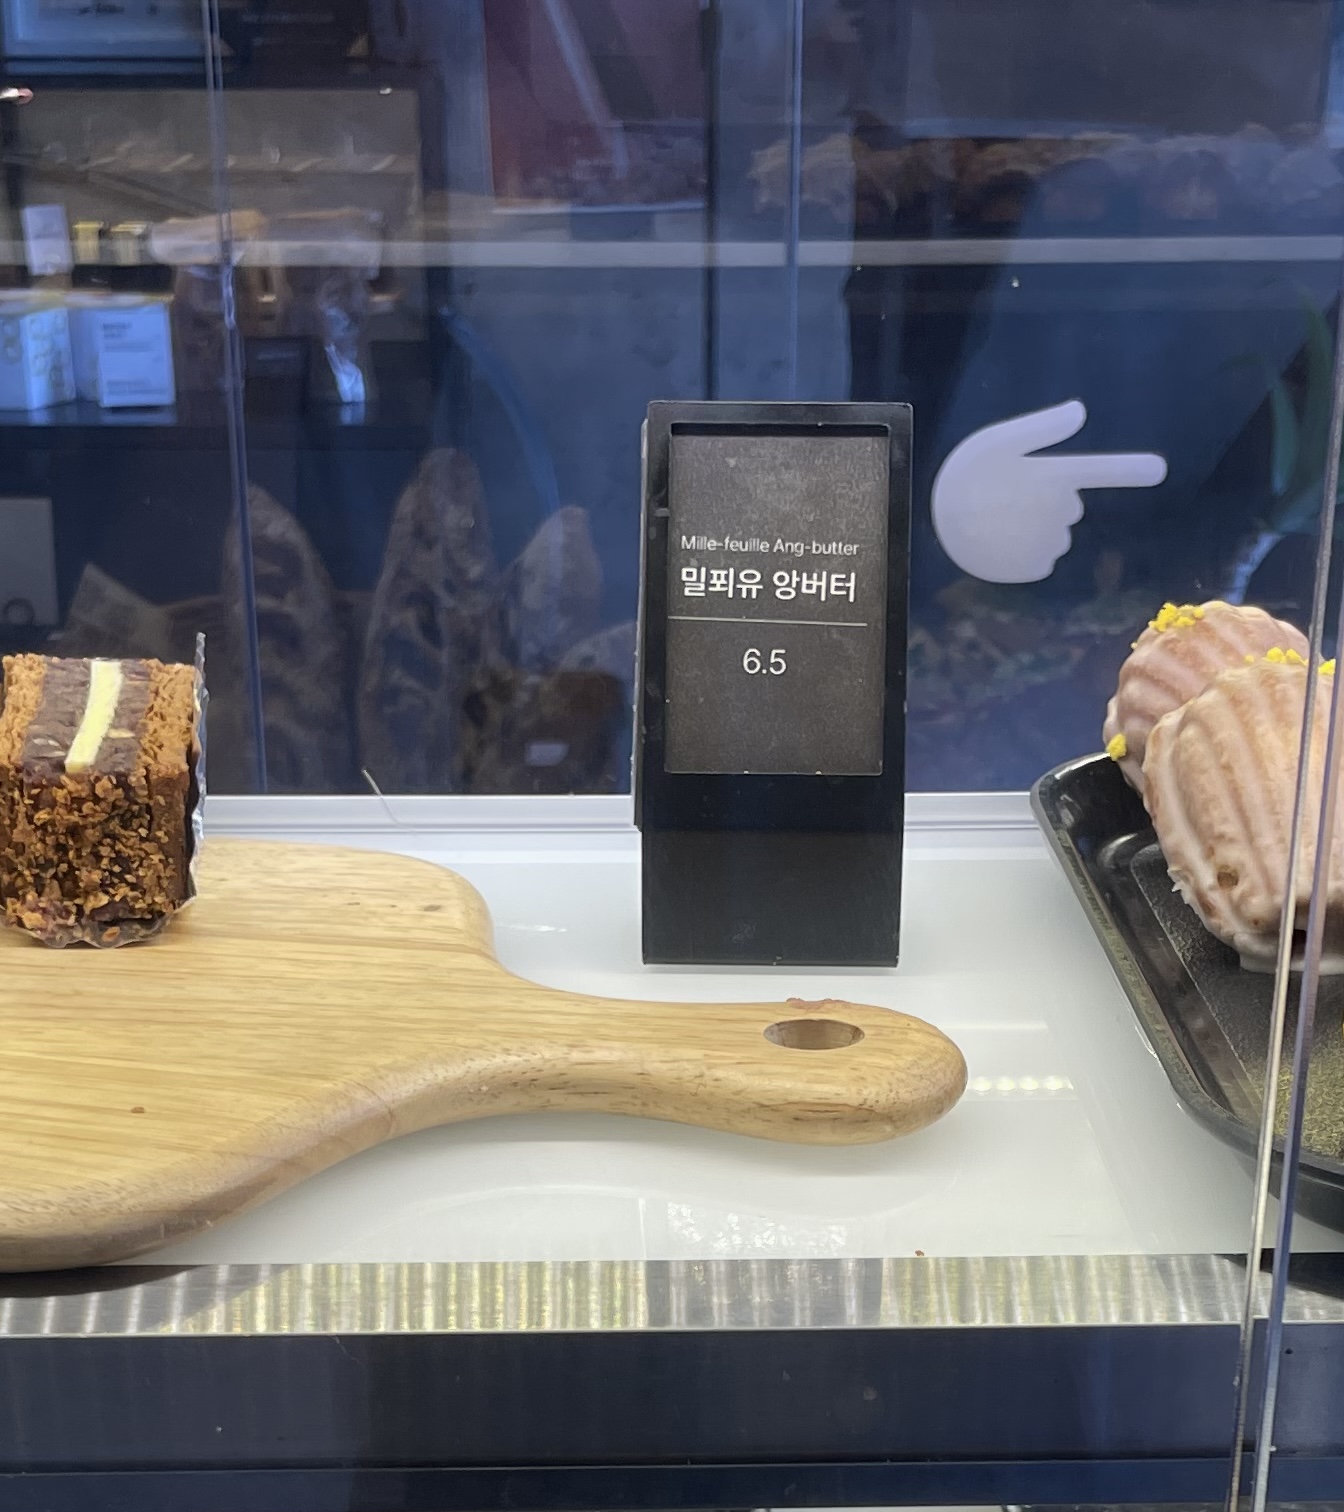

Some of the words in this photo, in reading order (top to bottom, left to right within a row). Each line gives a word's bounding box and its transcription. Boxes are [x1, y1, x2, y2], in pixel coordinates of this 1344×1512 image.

[680, 535, 770, 553] Mille-feuille
[772, 538, 860, 557] Ang-butter
[680, 566, 764, 600] 밀푀유
[772, 569, 857, 603] 앙버터
[742, 647, 788, 675] 6.5
